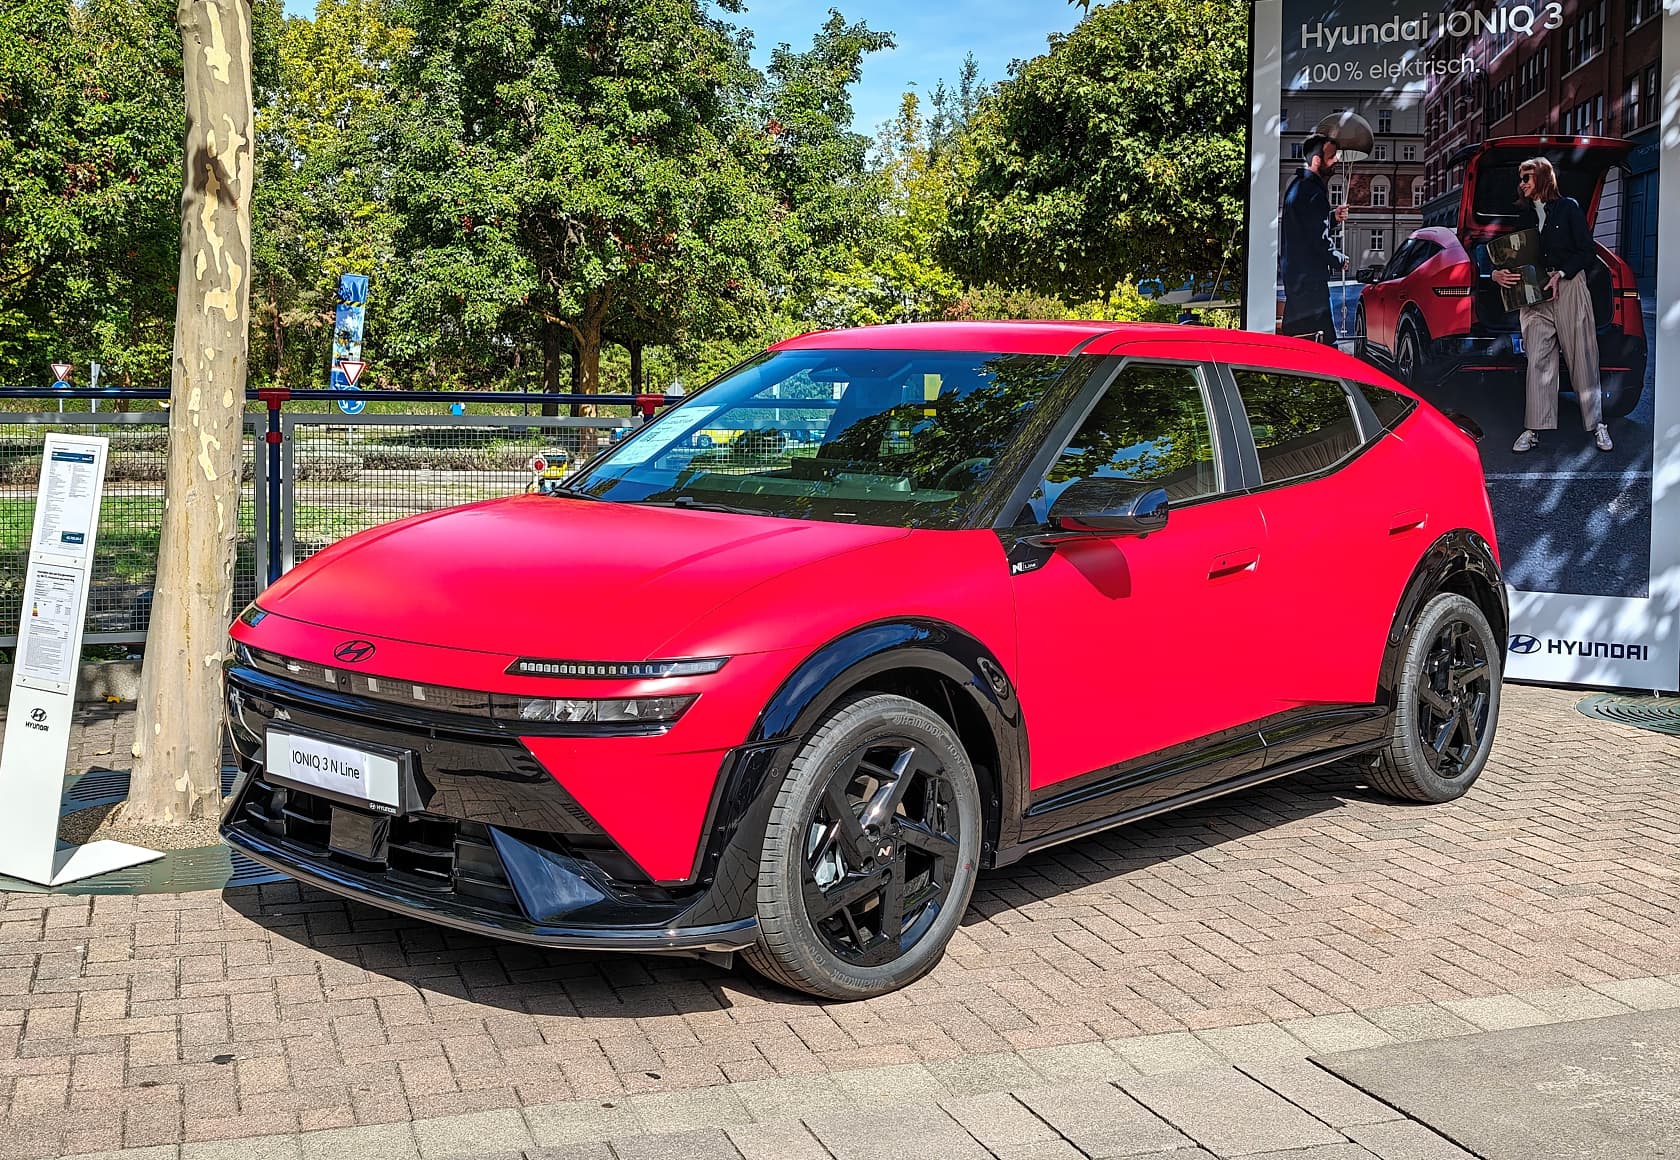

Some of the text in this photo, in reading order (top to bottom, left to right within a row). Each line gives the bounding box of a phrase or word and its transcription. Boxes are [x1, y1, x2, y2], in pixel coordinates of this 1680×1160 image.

[1301, 2, 1563, 53] Hyundai IONIQ 3
[1301, 53, 1480, 84] 100 % elektrisch.
[1547, 639, 1648, 661] HYUNDAI
[25, 721, 49, 731] HYUNDAI
[292, 750, 360, 780] IONIQ 3 N Line
